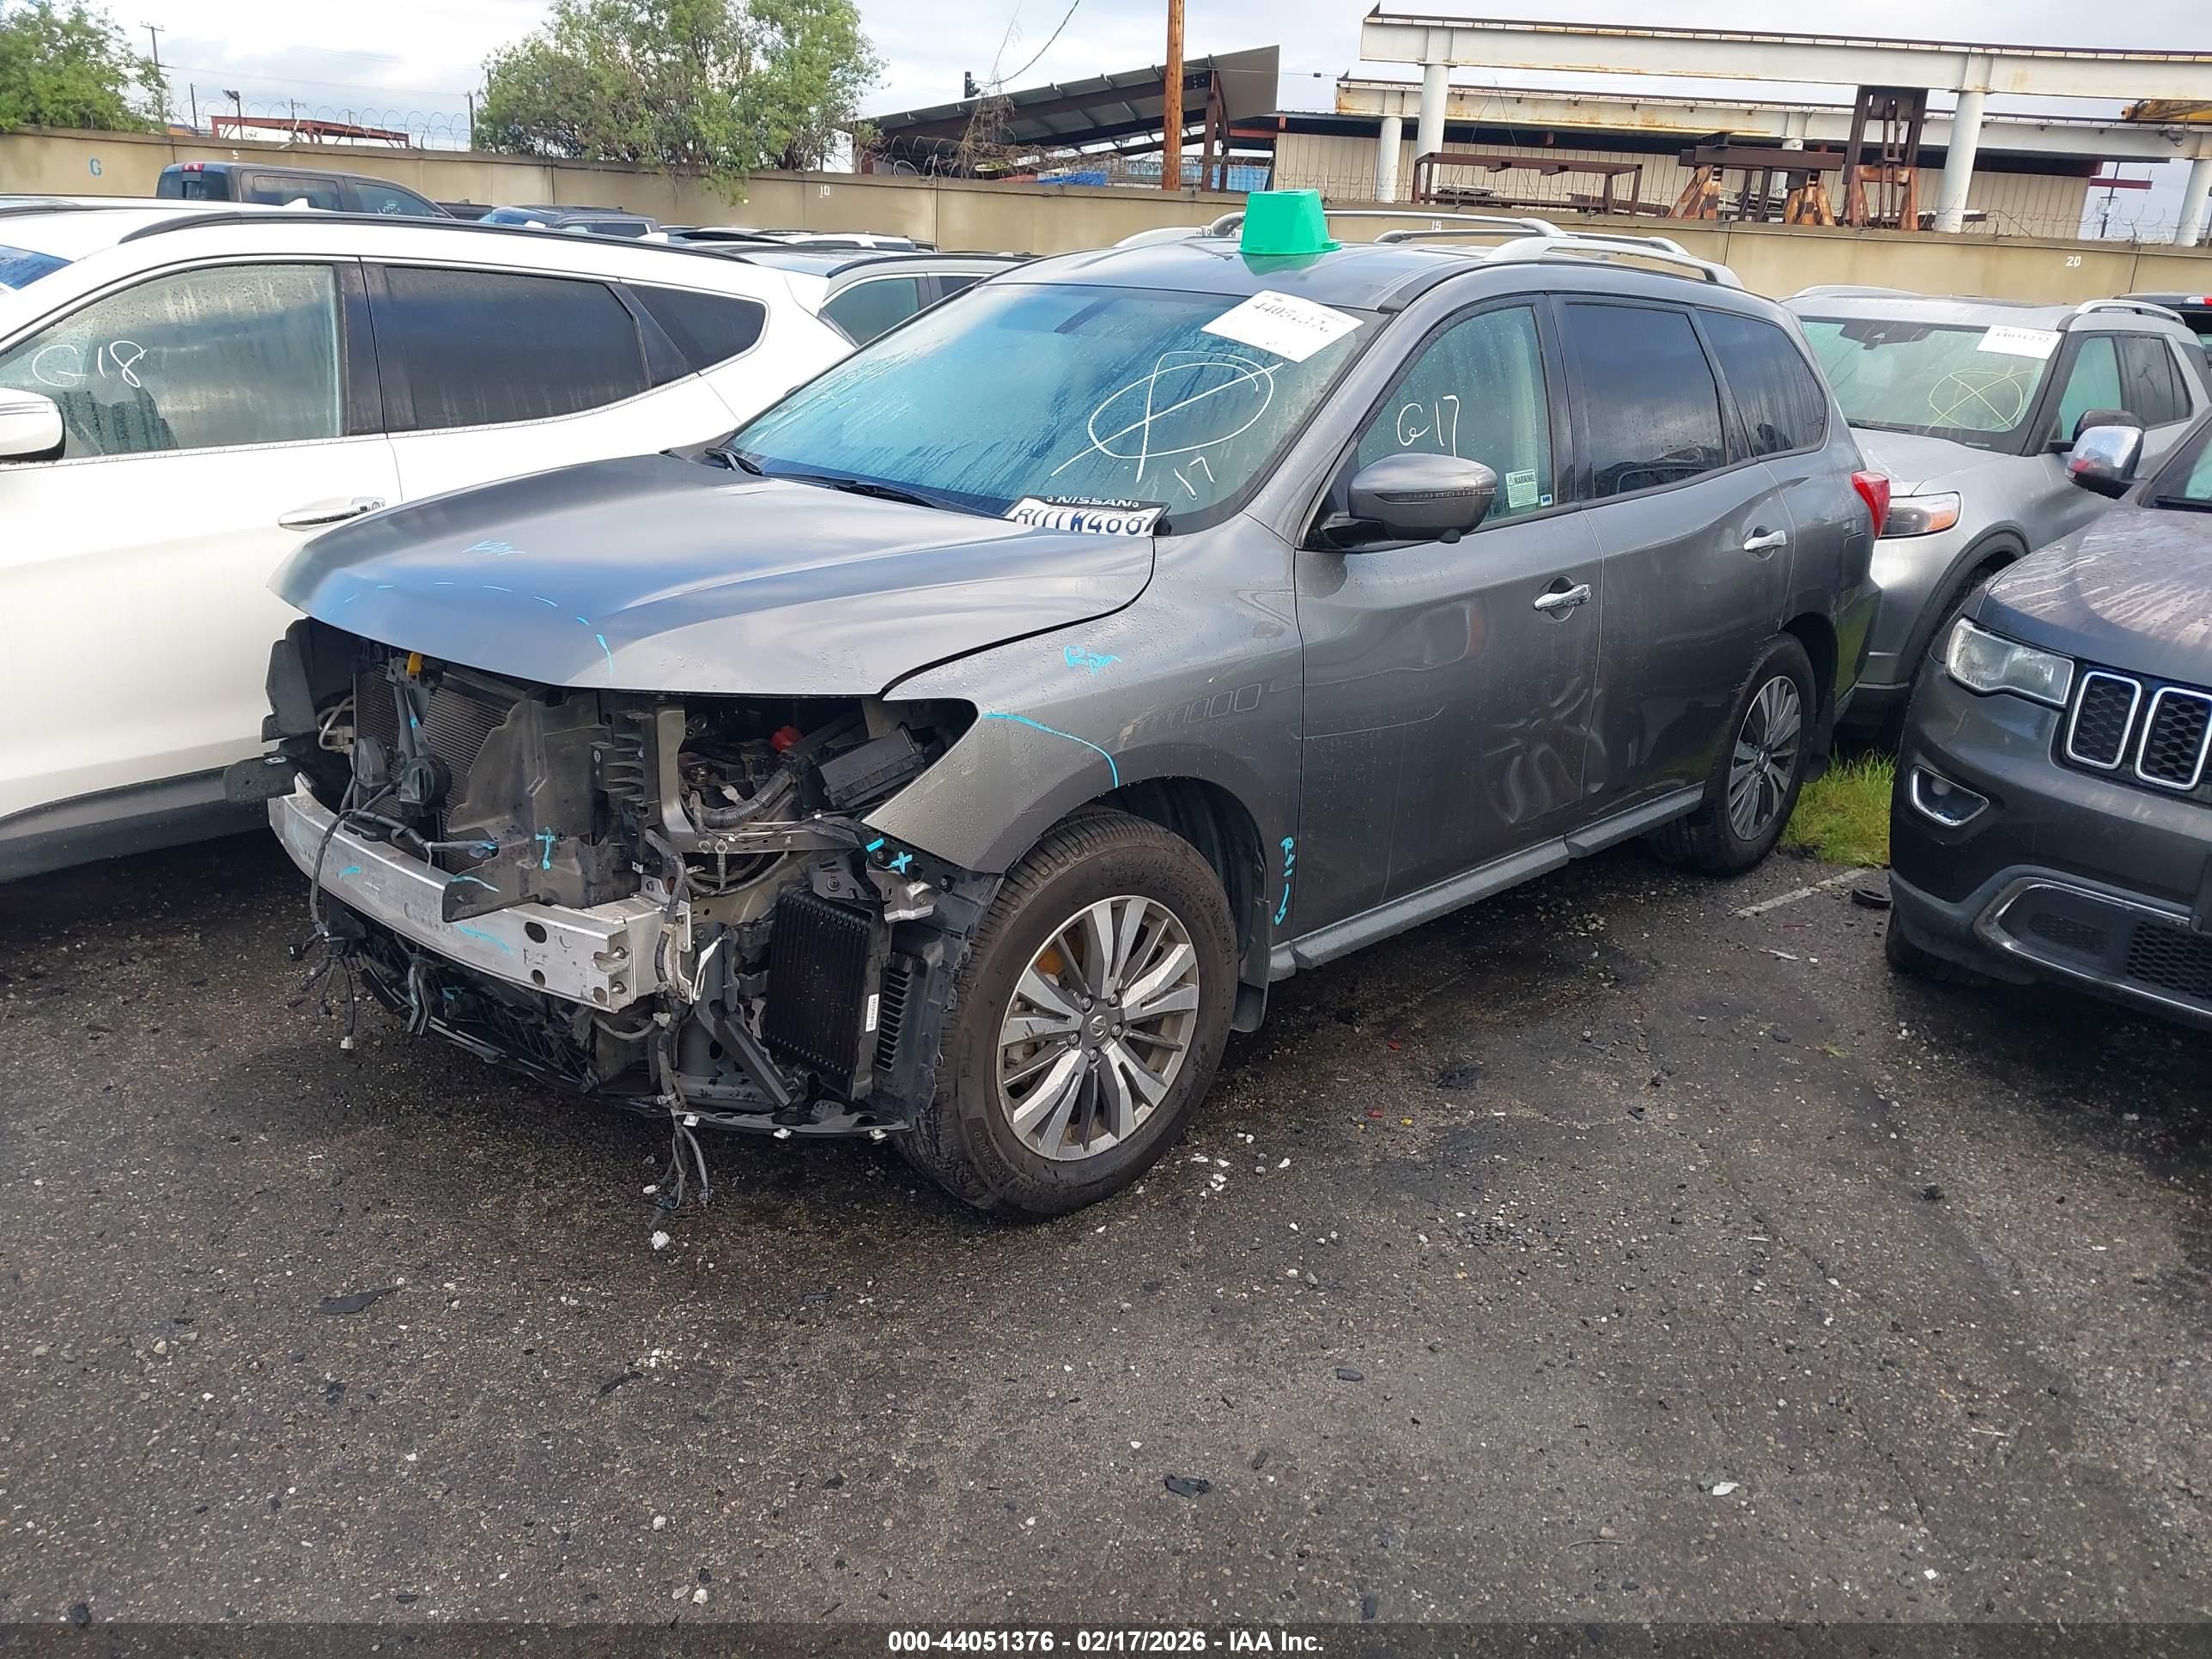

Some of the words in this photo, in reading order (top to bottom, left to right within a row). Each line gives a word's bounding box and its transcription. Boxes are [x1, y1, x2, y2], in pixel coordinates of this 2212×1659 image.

[819, 185, 830, 198] 10
[2065, 256, 2082, 268] 20
[32, 340, 148, 387] G18
[1397, 394, 1460, 458] G17
[1056, 495, 1133, 507] NISSAN
